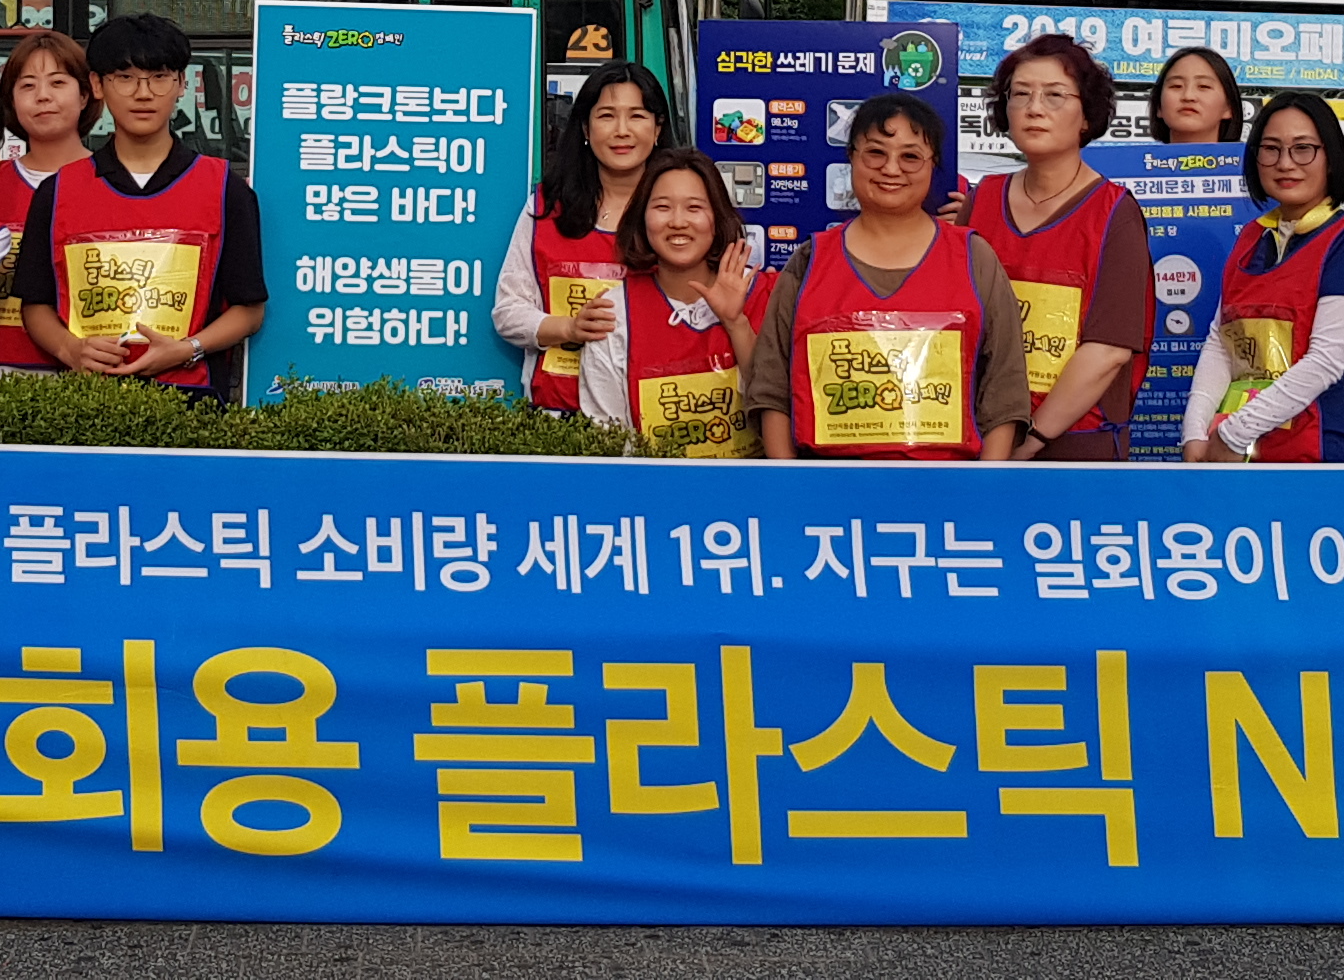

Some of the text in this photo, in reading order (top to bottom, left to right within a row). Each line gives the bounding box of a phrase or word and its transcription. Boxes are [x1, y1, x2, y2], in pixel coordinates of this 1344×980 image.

[282, 23, 374, 50] 플라스틱 ZERO
[716, 50, 876, 75] 심각한 쓰레기 문제
[281, 82, 508, 125] 플랑크톤보다
[299, 133, 486, 175] 플라스틱이
[305, 183, 477, 225] 많은 바다!
[1133, 178, 1232, 196] 장례문화 함께
[84, 248, 155, 288] 플라스틱
[295, 254, 483, 297] 해양생물이
[78, 286, 188, 318] ZERO 캠페인
[306, 306, 469, 347] 위험하다!
[658, 382, 734, 421] 플라스틱
[823, 380, 904, 416] ZERO
[2, 505, 272, 588] 플라스틱
[296, 510, 498, 593] 소비량
[515, 515, 651, 595] 세계
[669, 518, 784, 598] 1위.
[804, 518, 1000, 599] 지구는
[1023, 520, 1289, 600] 일회용이
[413, 644, 1140, 867] 플라스틱
